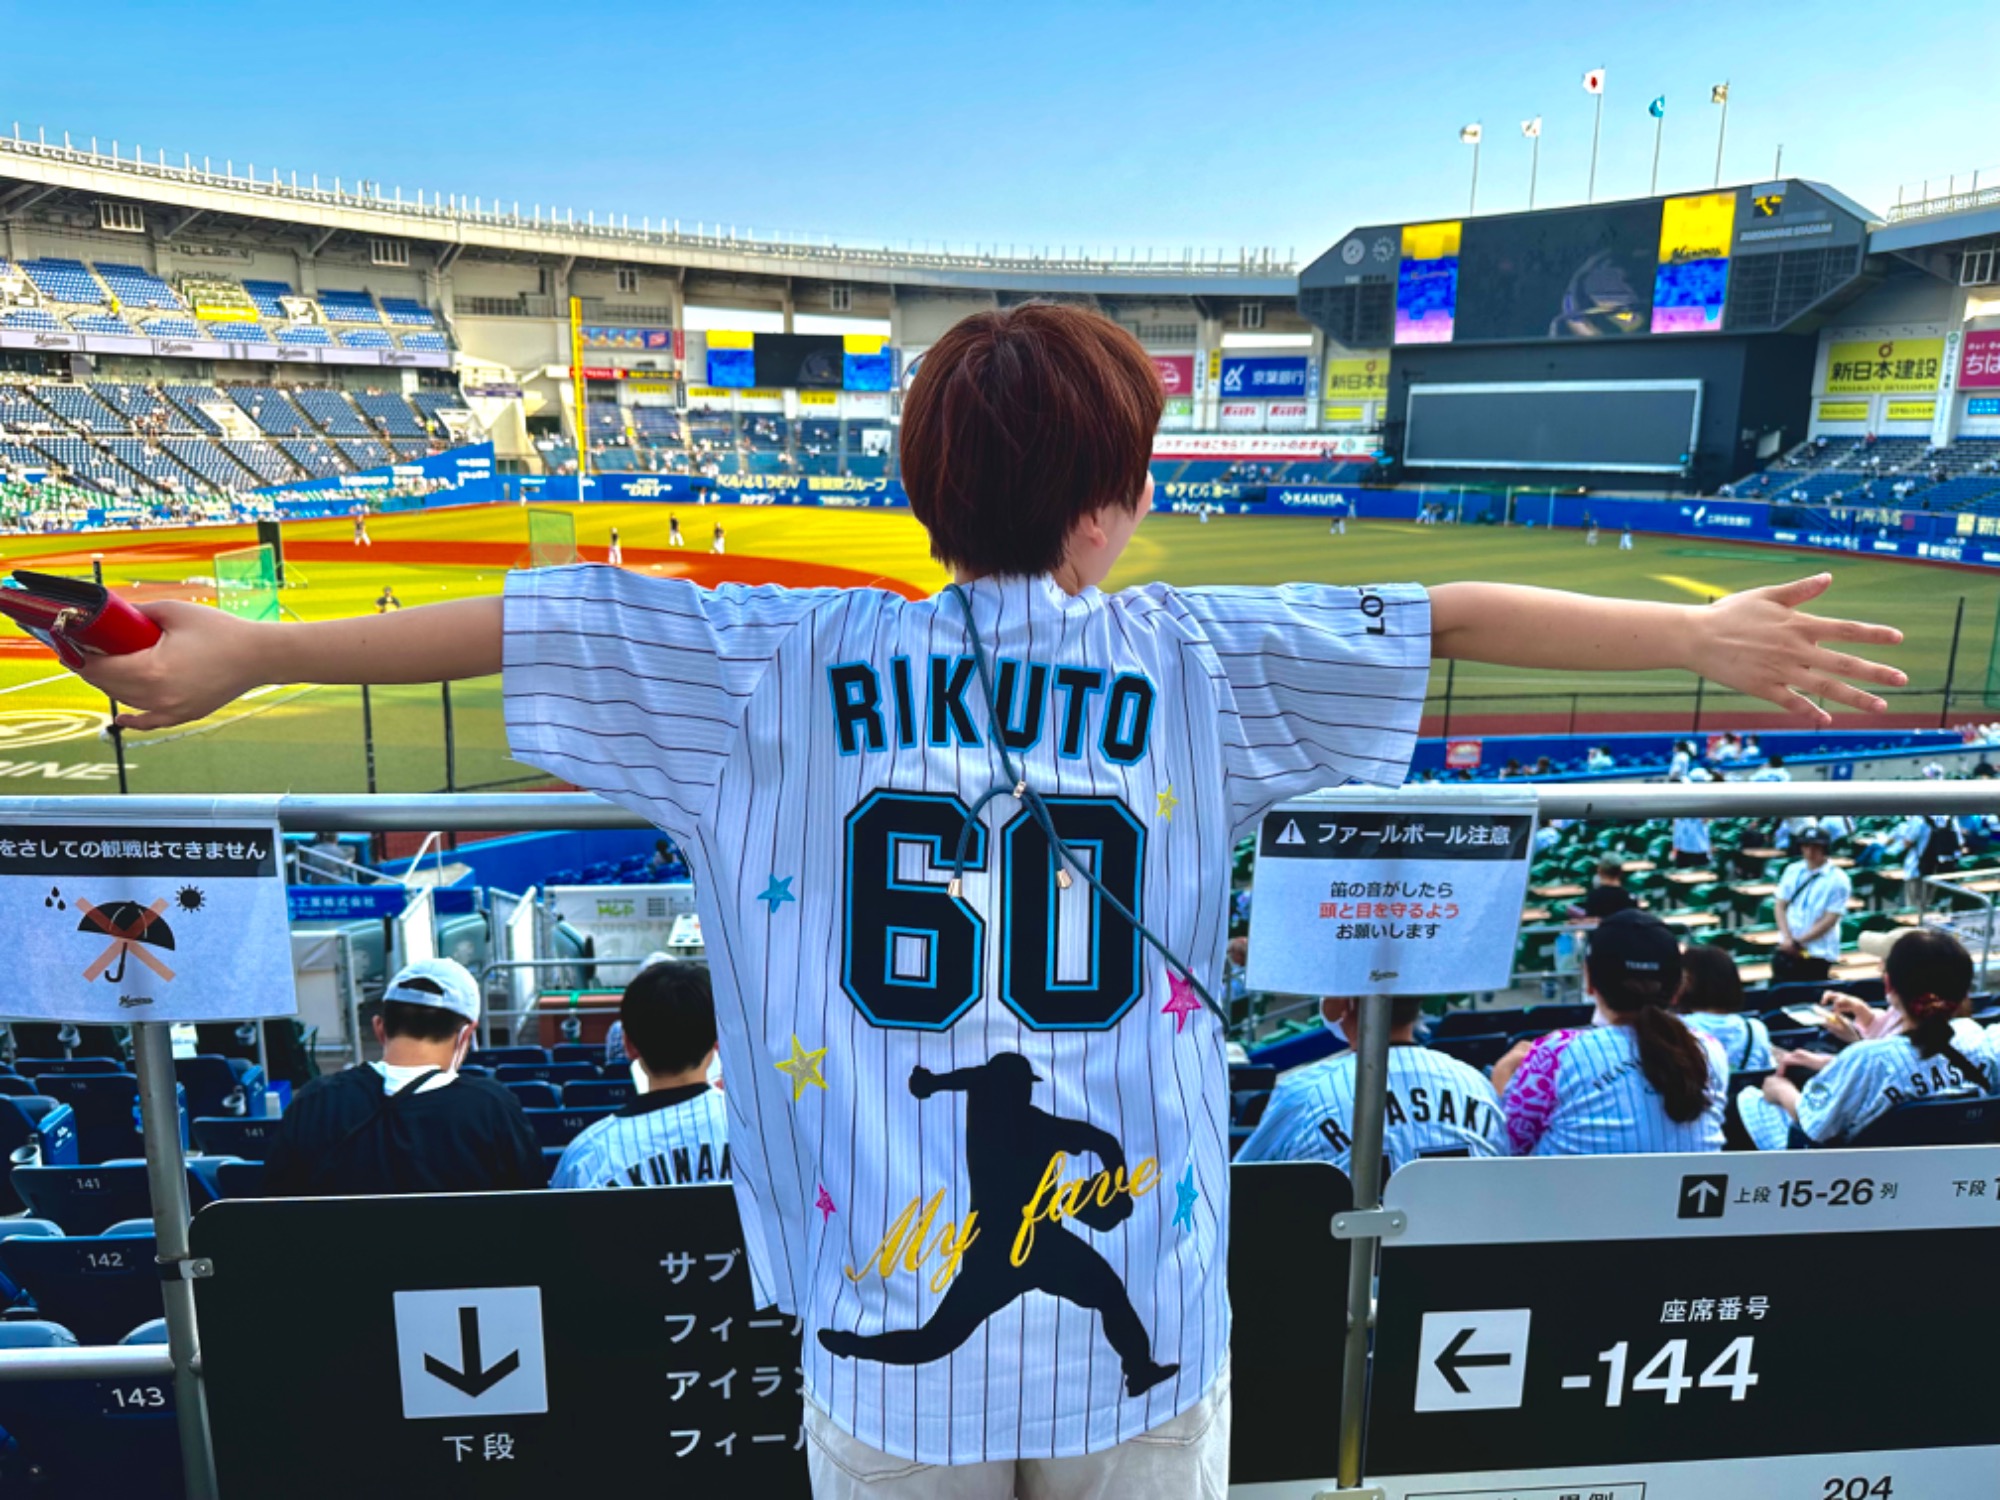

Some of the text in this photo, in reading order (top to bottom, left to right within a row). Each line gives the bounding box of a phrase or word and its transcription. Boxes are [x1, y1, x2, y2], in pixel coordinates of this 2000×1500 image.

[1830, 357, 1938, 382] 新日本建設
[826, 654, 1157, 767] RIKUTO
[1318, 823, 1511, 845] ファールボール注意
[1330, 881, 1454, 899] 笛の音がしたら
[840, 787, 1148, 1033] 60
[1319, 902, 1460, 920] 頭と目を守るよう
[1335, 923, 1441, 940] お願いします
[76, 1177, 101, 1190] 141
[1734, 1187, 1771, 1204] 上段
[1777, 1178, 1875, 1208] 15-26
[1880, 1182, 1898, 1200] 列
[1952, 1180, 1988, 1197] 下段
[845, 1151, 1163, 1293] My fave
[87, 1252, 125, 1268] 142
[1660, 1296, 1770, 1323] 座席番号
[1560, 1336, 1760, 1408] -144
[111, 1387, 166, 1408] 143
[442, 1432, 516, 1463] 下段
